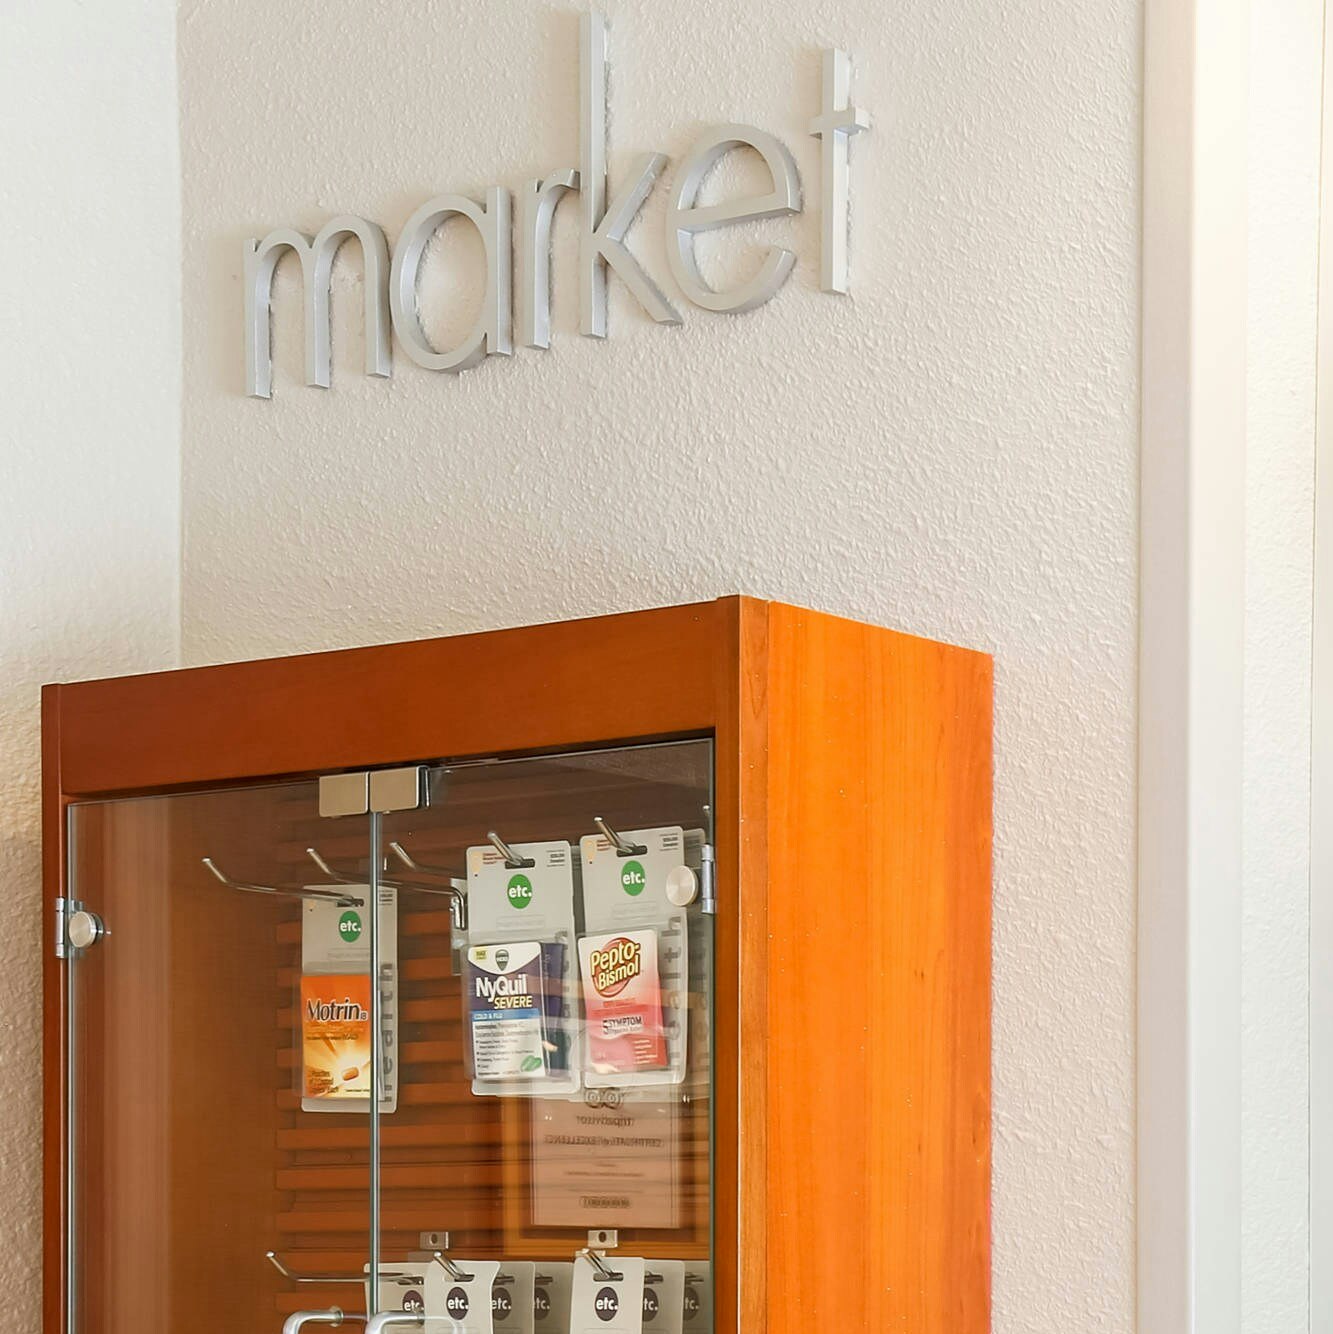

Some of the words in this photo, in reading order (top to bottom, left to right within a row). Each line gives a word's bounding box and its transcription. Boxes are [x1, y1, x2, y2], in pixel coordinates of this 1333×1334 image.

[244, 8, 871, 400] market
[622, 871, 646, 885] etc.
[508, 884, 533, 898] etc.
[339, 919, 362, 933] etc.
[597, 954, 640, 991] Bismol
[475, 973, 529, 1003] NyQuil
[306, 997, 361, 1022] Motrin
[493, 995, 534, 1010] SEVERE
[447, 1296, 469, 1310] etc.
[595, 1296, 619, 1311] etc.
